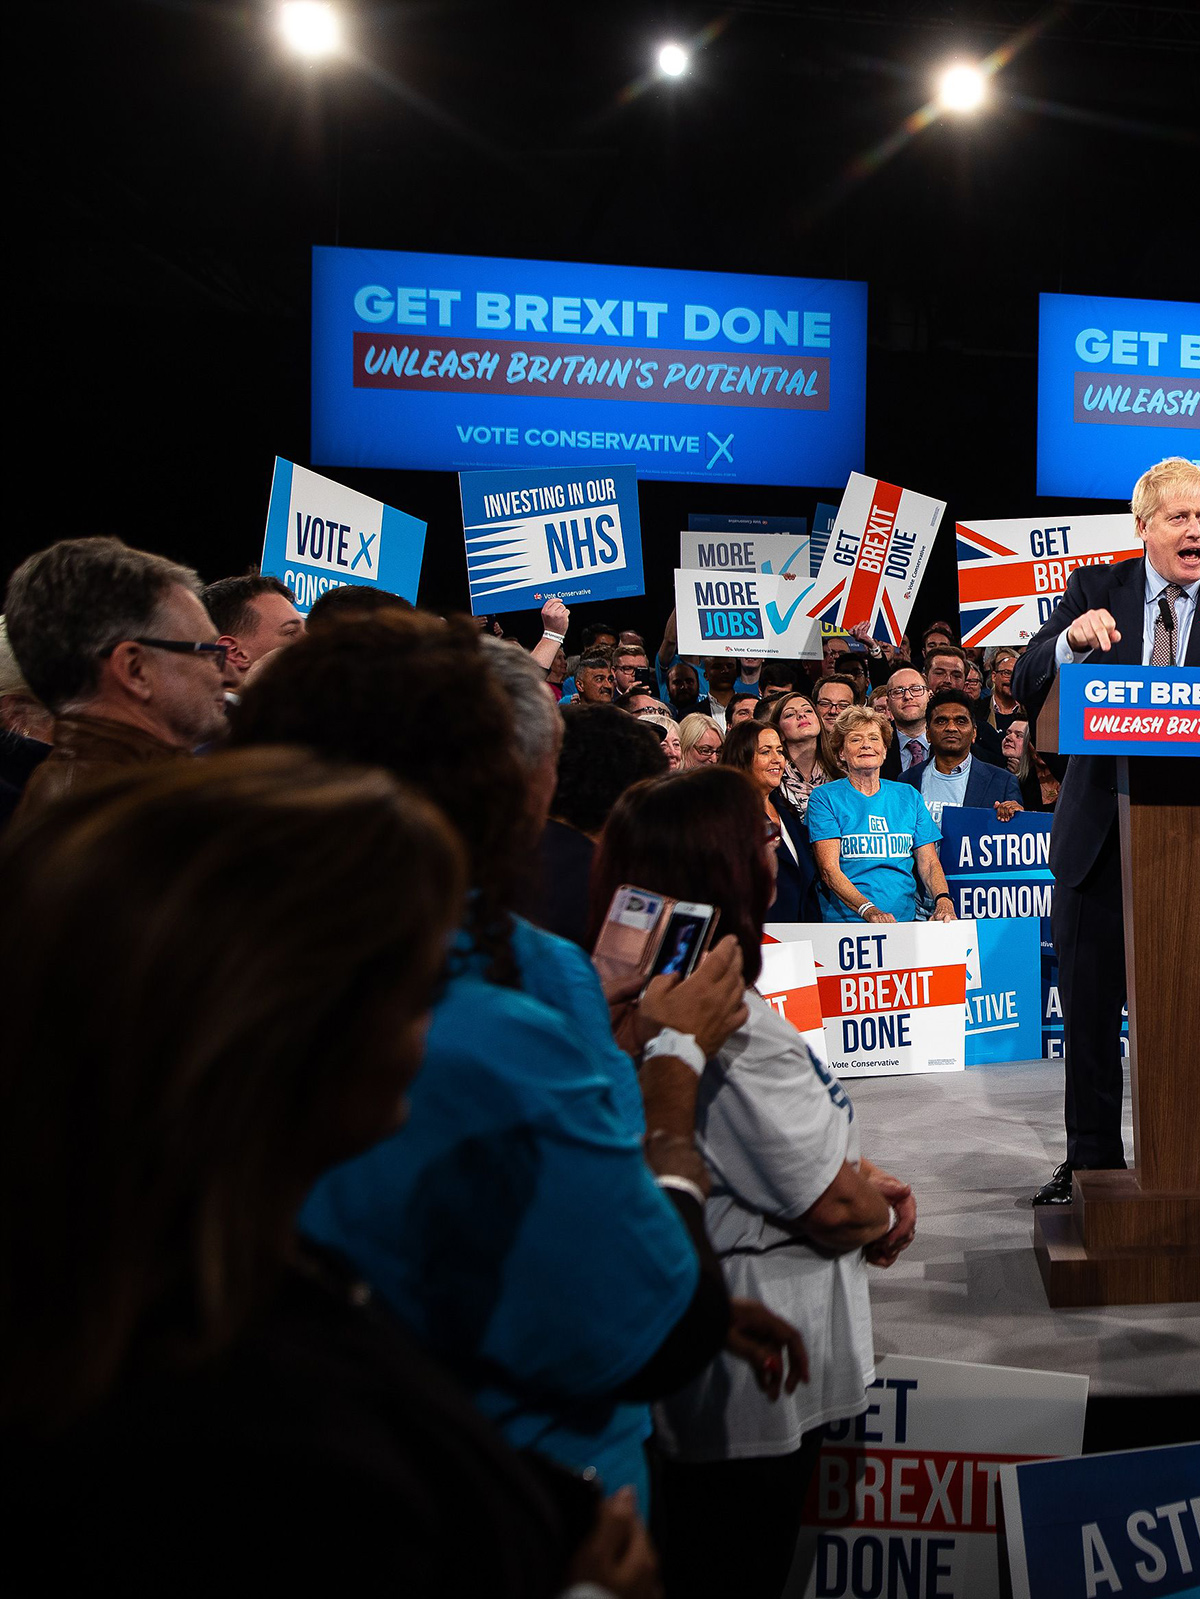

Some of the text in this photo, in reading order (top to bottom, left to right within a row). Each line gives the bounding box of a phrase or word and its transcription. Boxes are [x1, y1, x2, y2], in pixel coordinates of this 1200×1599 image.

[353, 285, 831, 348] GET BREXIT DONE
[1075, 328, 1168, 366] GET
[364, 346, 819, 397] UNLEASH BRITAIN'S POTENTIAL
[1083, 384, 1200, 416] UNLEASH
[456, 425, 519, 446] VOTE
[524, 427, 700, 454] CONSERVATIVE
[484, 477, 616, 519] INVESTING IN OUR
[296, 511, 351, 567] VOTE
[544, 513, 619, 575] NHS
[697, 542, 756, 568] MORE
[833, 529, 862, 566] GET
[858, 504, 895, 574] BREXIT
[884, 528, 917, 581] DONE
[1030, 526, 1071, 558] GET
[1032, 555, 1114, 593] BRE
[694, 581, 760, 606] MORE
[704, 610, 759, 638] JOBS
[1084, 679, 1144, 704] GET
[1089, 715, 1162, 734] UNLEASH
[870, 817, 886, 832] GET
[842, 836, 884, 855] BREXIT
[958, 832, 1051, 868] A STRON
[960, 885, 1053, 919] ECONOM
[838, 934, 887, 971] GET
[840, 970, 934, 1013] BREXIT
[1046, 986, 1063, 1018] A
[842, 1013, 912, 1053] DONE
[832, 1059, 899, 1069] Vote Conservative
[818, 1457, 1000, 1525] BREXIT
[815, 1535, 955, 1599] DONE
[1081, 1522, 1123, 1598] A
